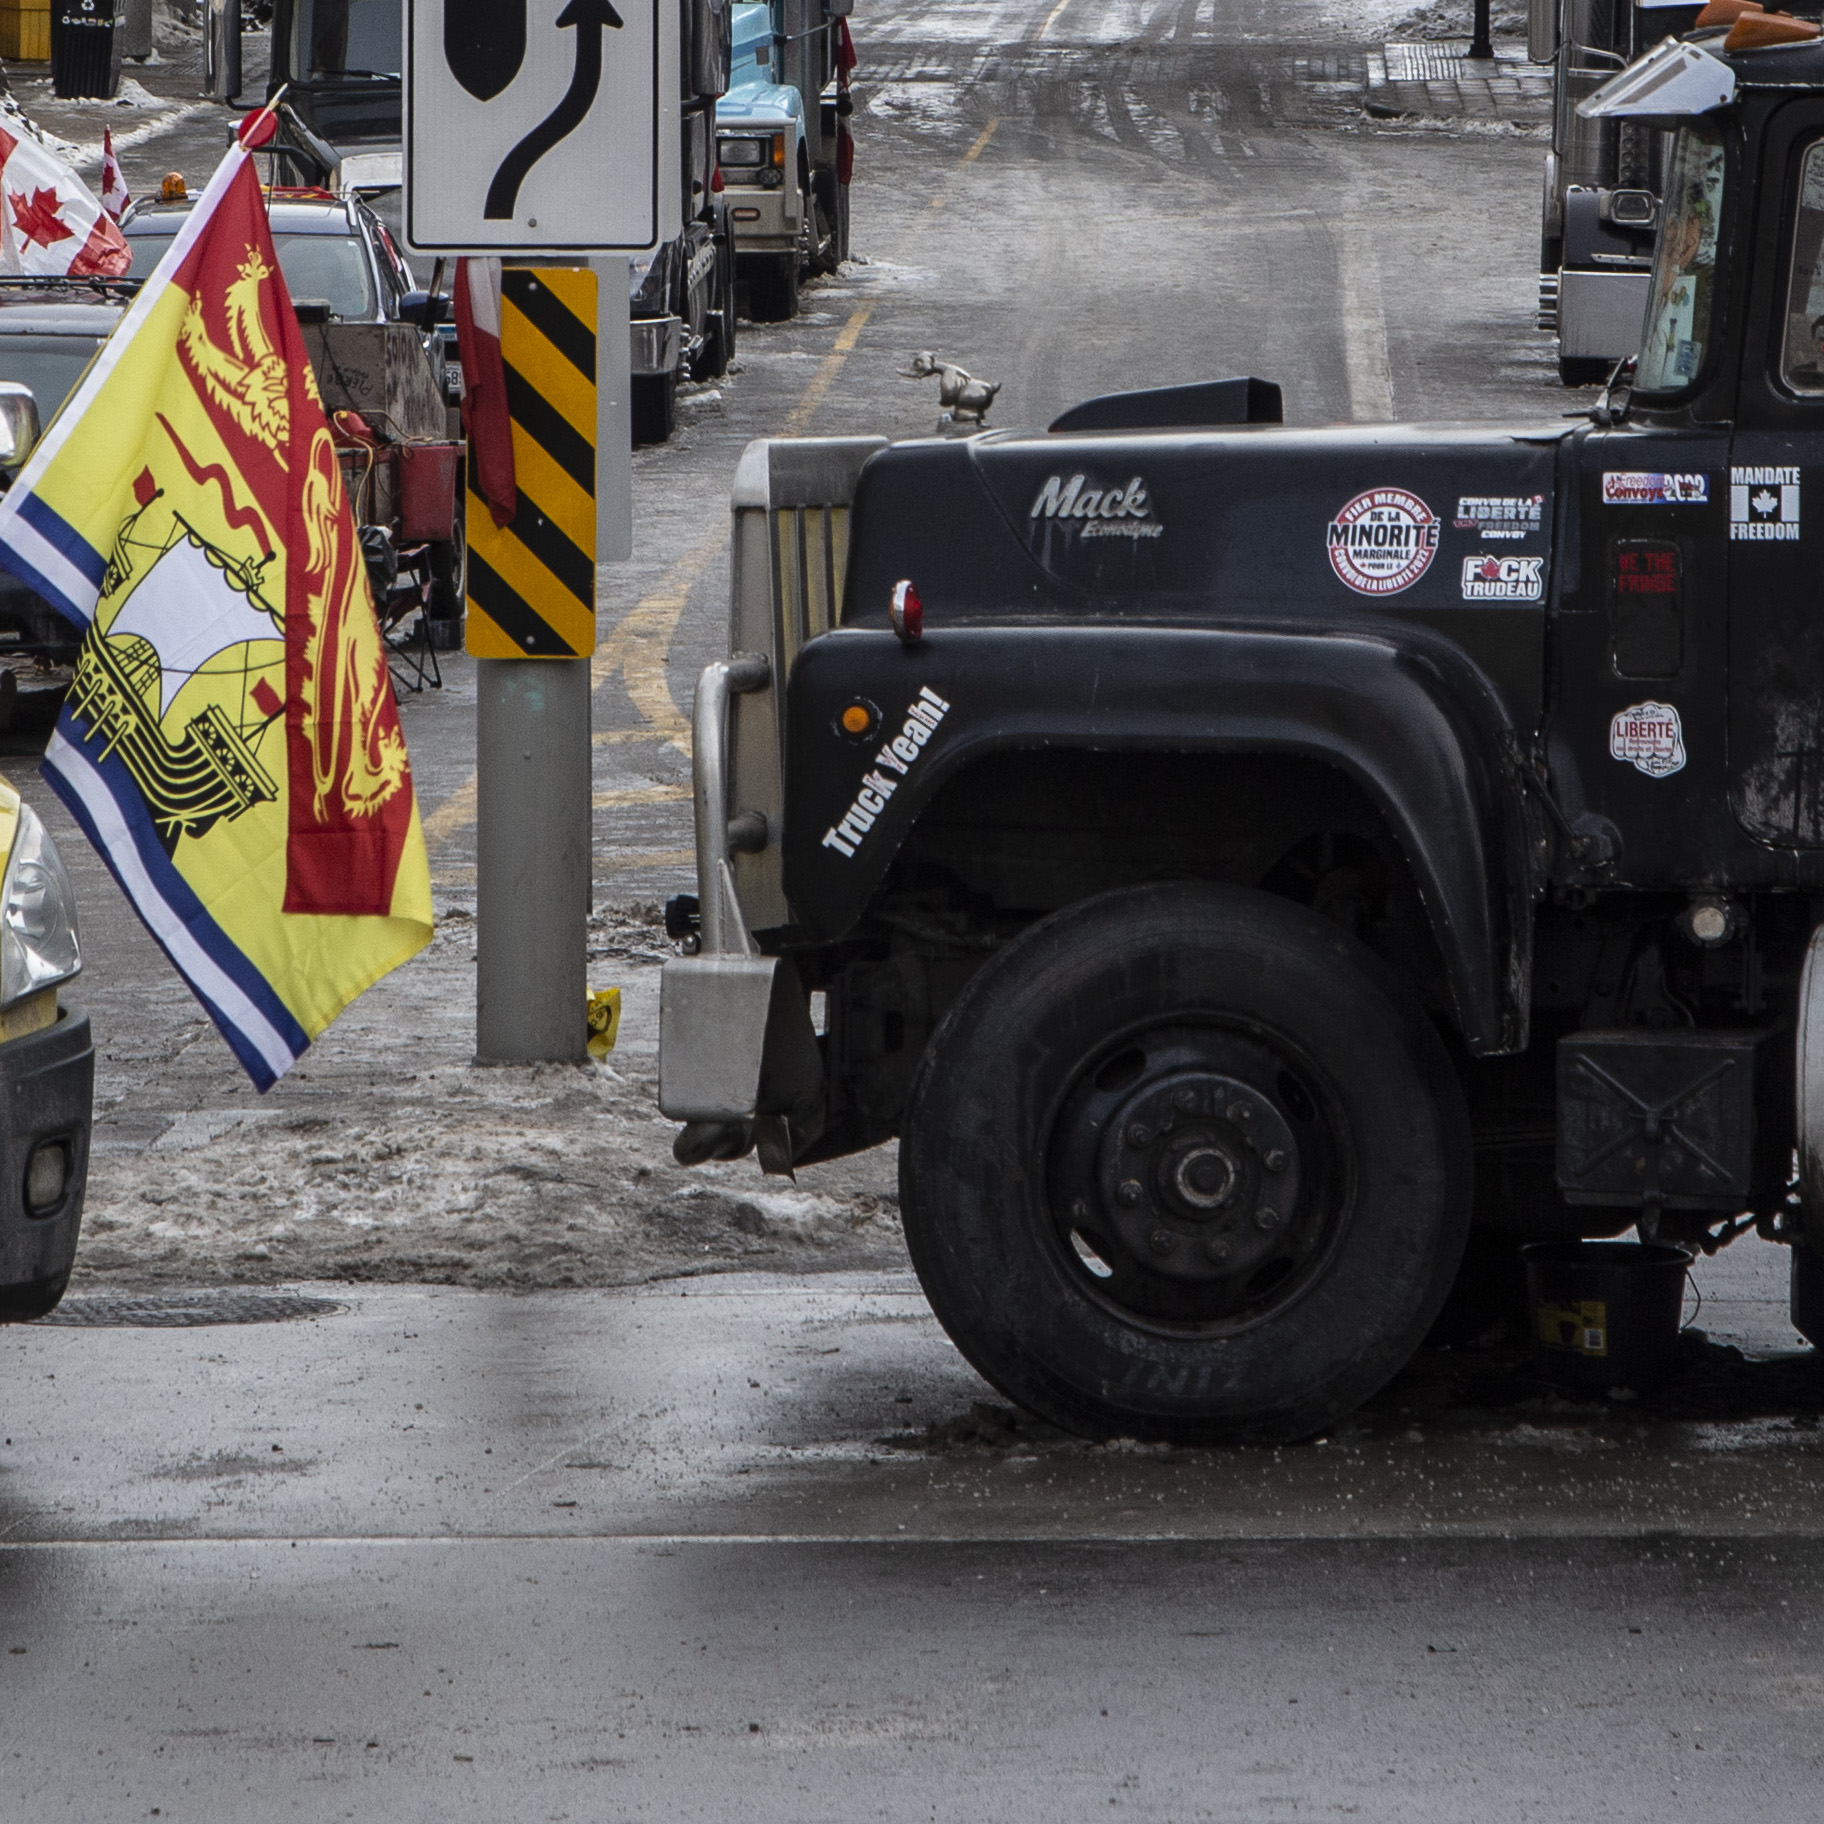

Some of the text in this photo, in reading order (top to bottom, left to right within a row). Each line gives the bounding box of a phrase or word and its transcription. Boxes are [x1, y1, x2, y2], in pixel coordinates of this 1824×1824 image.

[1621, 474, 1664, 487] Freedom
[1730, 466, 1801, 485] MANDATE
[1030, 474, 1149, 518] Mack
[1606, 473, 1708, 502] Convoys 2022
[1344, 492, 1427, 523] FIER MEMBRE
[1457, 503, 1542, 520] LIBERTÉ
[1458, 497, 1533, 507] CONVOI DE LA
[1370, 511, 1401, 522] DE LA
[1328, 517, 1441, 548] MINORITÉ
[1477, 521, 1540, 532] FREEDOM
[1480, 530, 1527, 540] CONVOY
[1730, 522, 1800, 541] FREEDOM
[1352, 548, 1411, 561] MARGINALE
[1618, 552, 1675, 572] WE THE
[1465, 560, 1540, 582] FCK
[1465, 581, 1539, 596] TRUDEAU
[1618, 574, 1676, 593] FRINGE
[1616, 718, 1674, 738] LIBERTÉ
[821, 769, 898, 858] Truck
[875, 685, 951, 776] Yeah!
